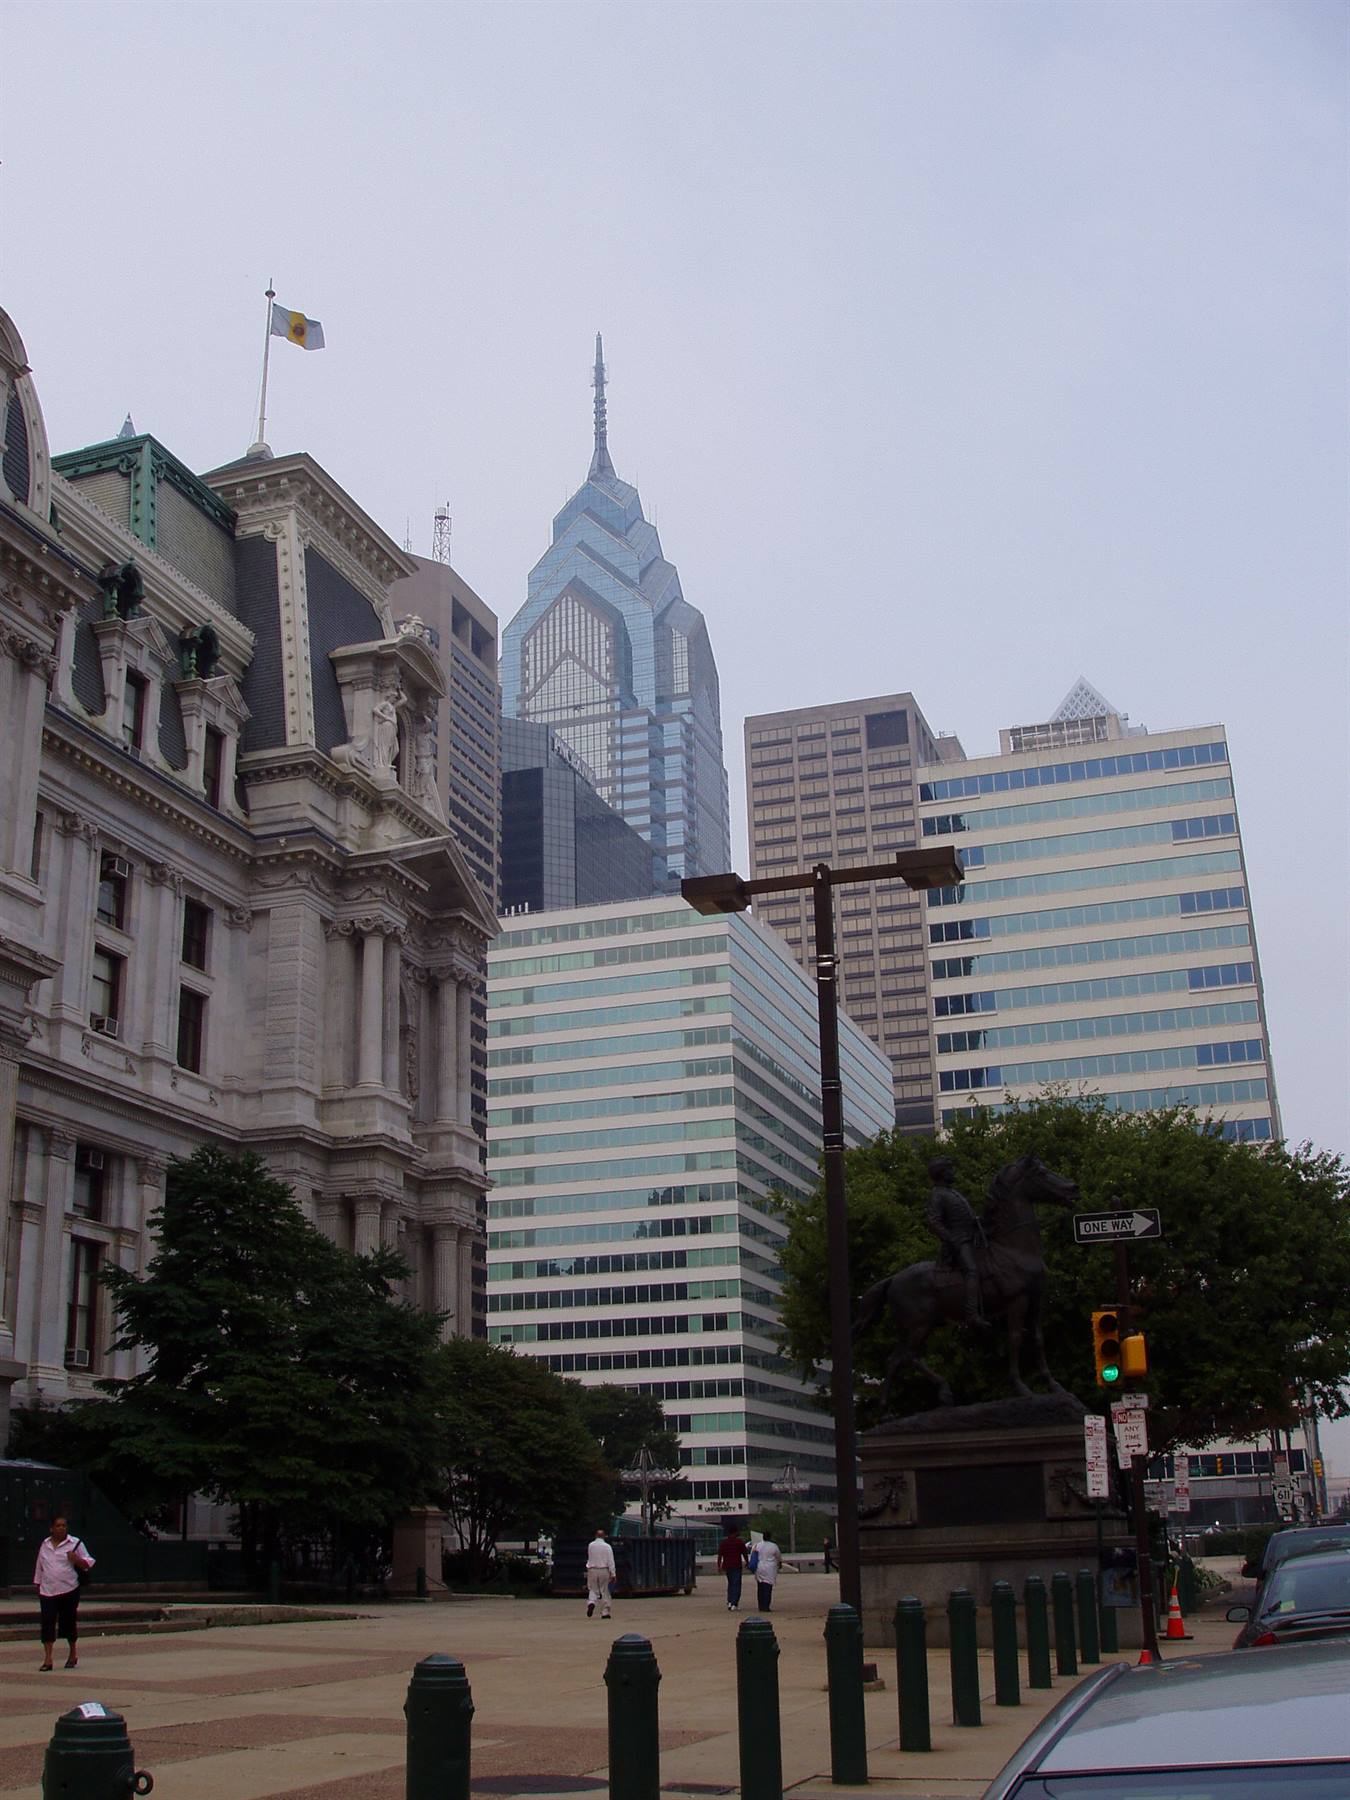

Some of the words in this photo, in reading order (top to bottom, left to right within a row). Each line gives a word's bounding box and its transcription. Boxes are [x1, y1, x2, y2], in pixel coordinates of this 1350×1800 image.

[1084, 1221, 1108, 1233] ONE
[1111, 1219, 1134, 1231] WAY
[1118, 1413, 1127, 1423] NO
[1124, 1425, 1140, 1433] ANY
[1278, 1490, 1289, 1499] 611
